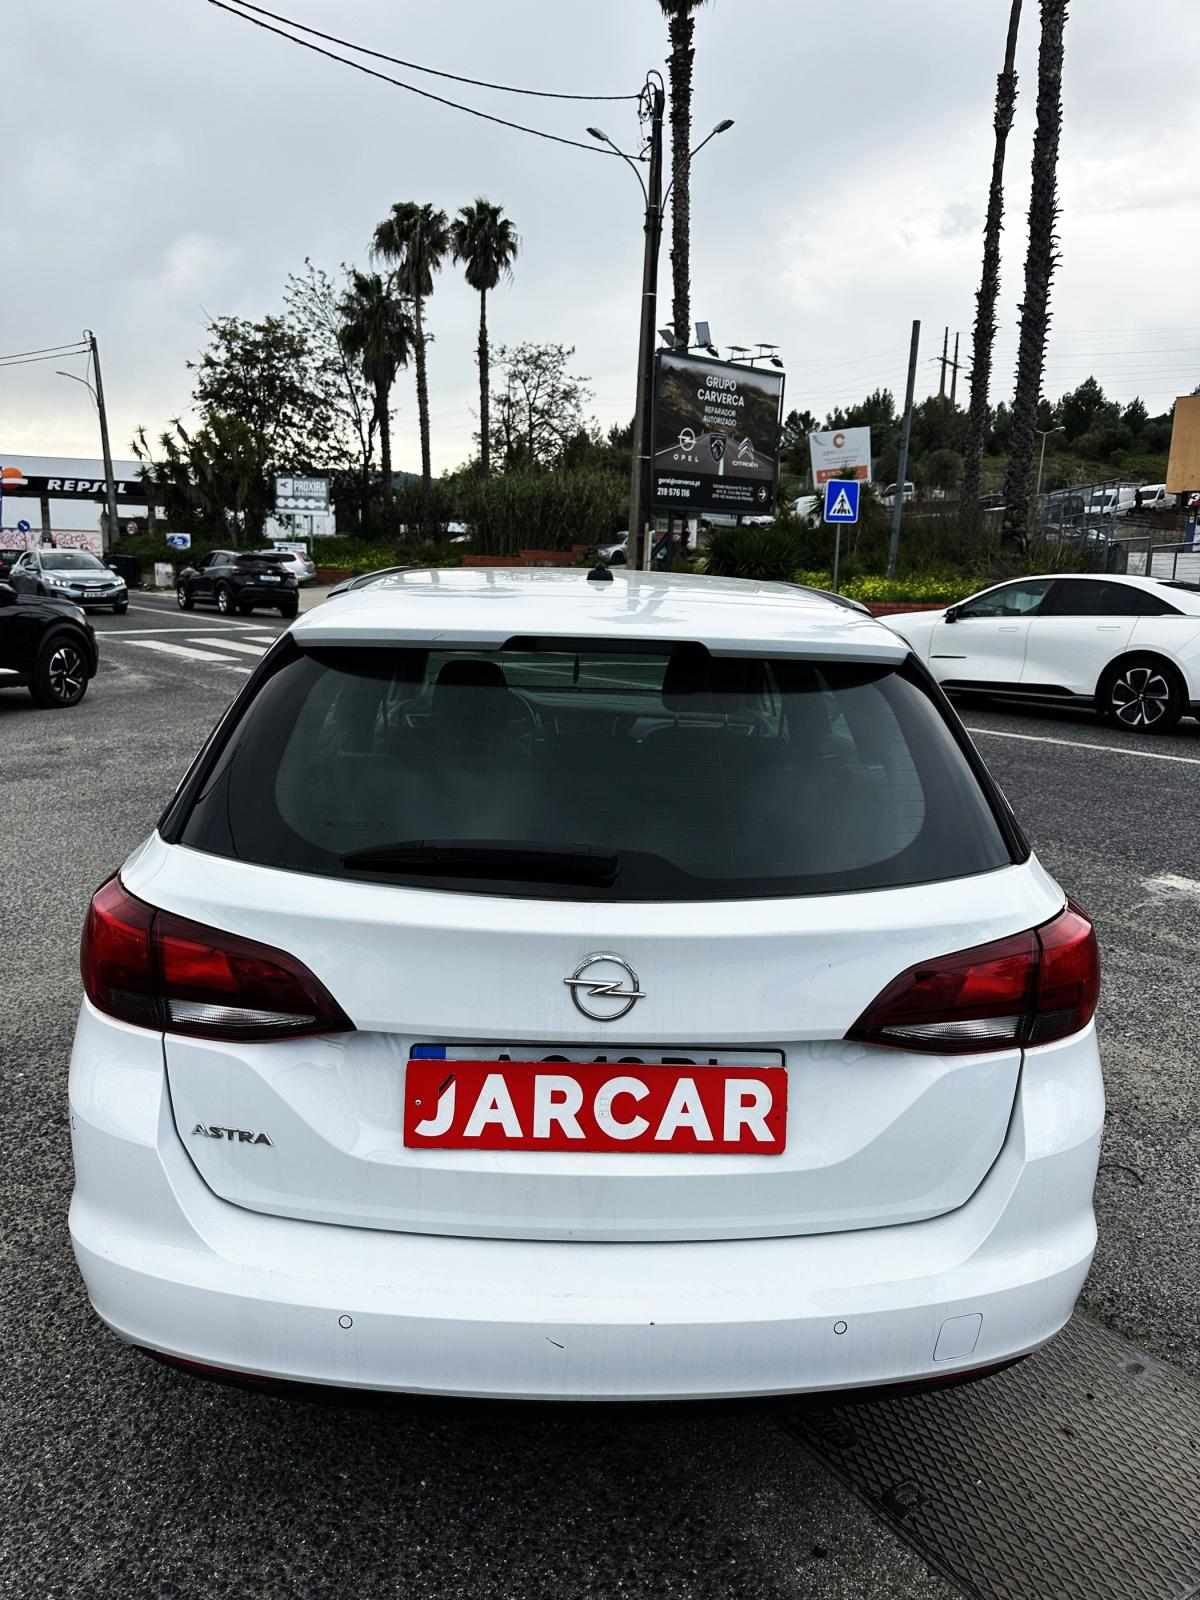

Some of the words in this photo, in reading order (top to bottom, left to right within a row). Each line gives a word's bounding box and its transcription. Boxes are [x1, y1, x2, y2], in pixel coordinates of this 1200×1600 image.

[706, 376, 737, 391] GRUPO
[697, 388, 745, 407] CARVERCA
[673, 454, 699, 463] OPEL
[47, 479, 127, 494] REPSL
[414, 1073, 776, 1142] JARCAR
[192, 1123, 272, 1146] ASTRA
